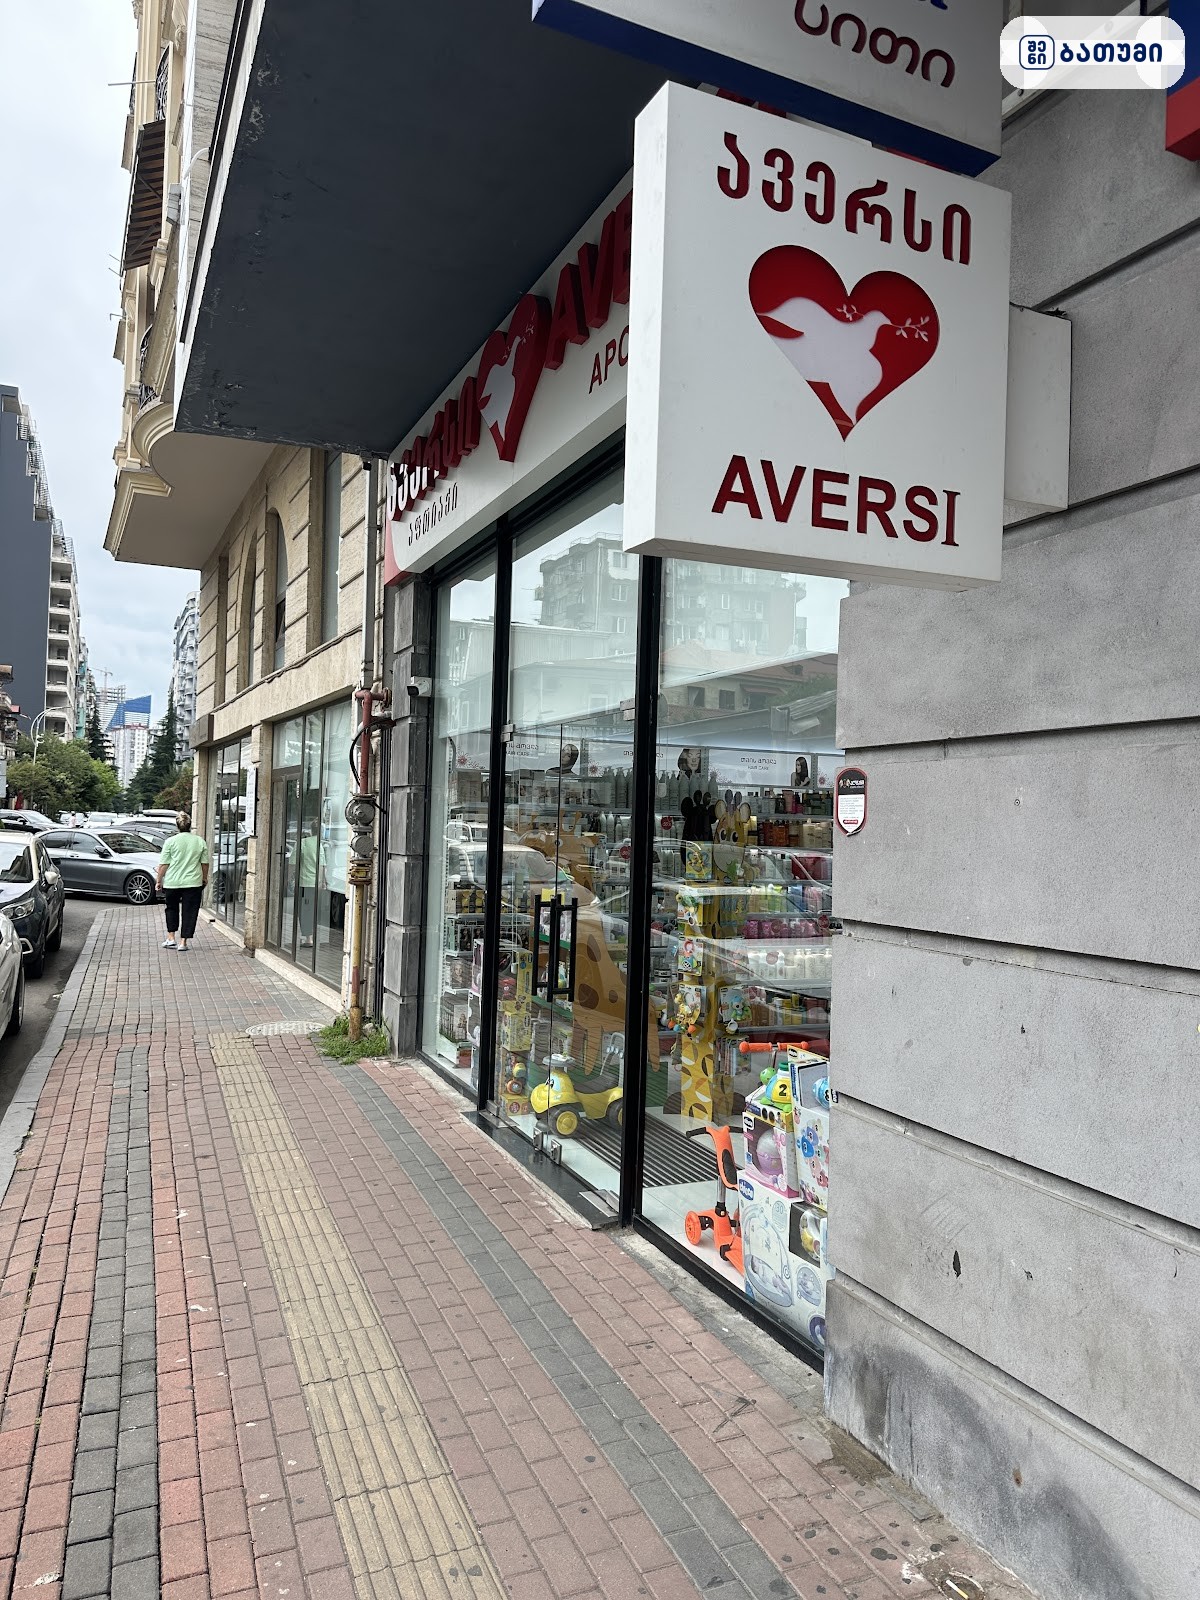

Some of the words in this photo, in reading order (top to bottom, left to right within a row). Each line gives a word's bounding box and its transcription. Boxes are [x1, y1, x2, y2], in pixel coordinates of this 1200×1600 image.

[716, 132, 973, 266] ავერსი
[408, 482, 458, 546] აფთიაქი
[711, 454, 961, 548] AVERSI
[778, 1083, 788, 1097] 2
